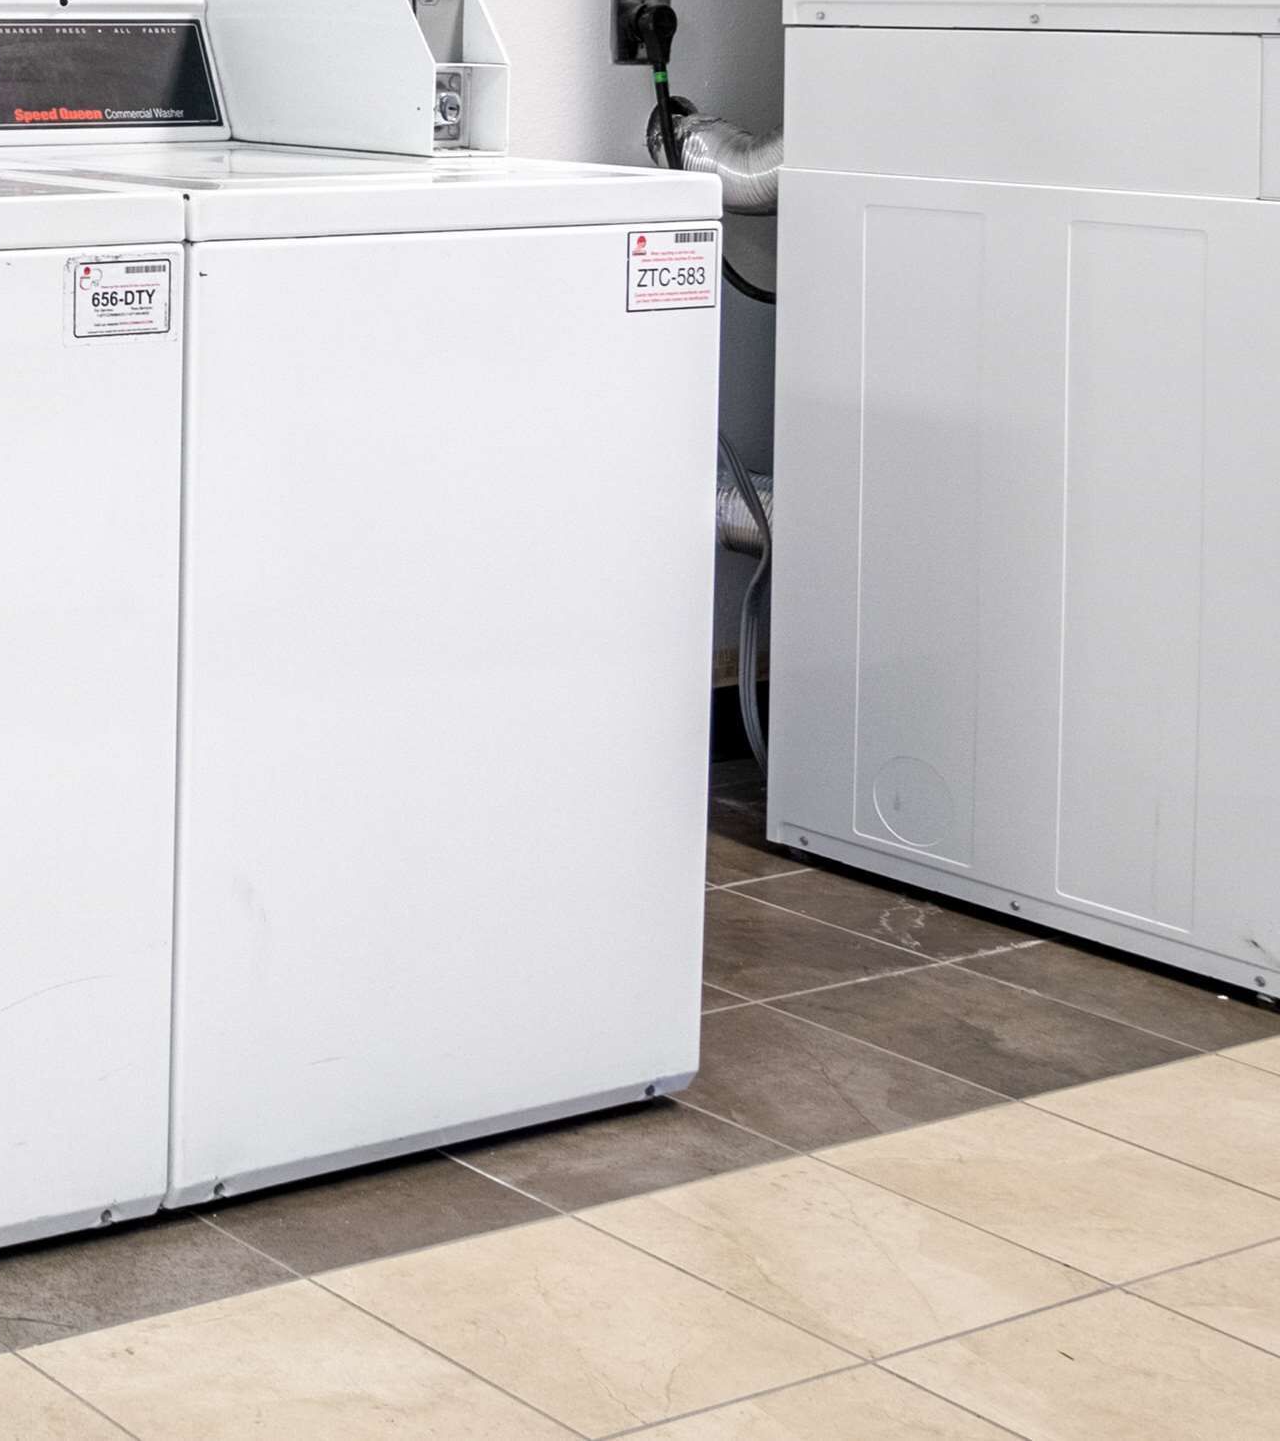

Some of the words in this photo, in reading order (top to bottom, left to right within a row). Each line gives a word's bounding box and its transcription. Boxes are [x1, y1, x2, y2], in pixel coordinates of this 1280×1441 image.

[15, 108, 57, 123] Speed
[60, 107, 103, 121] Queen
[105, 108, 152, 120] Commercial
[154, 107, 184, 118] Washer
[637, 267, 705, 287] ZTC-583
[92, 289, 155, 307] 656-DTY
